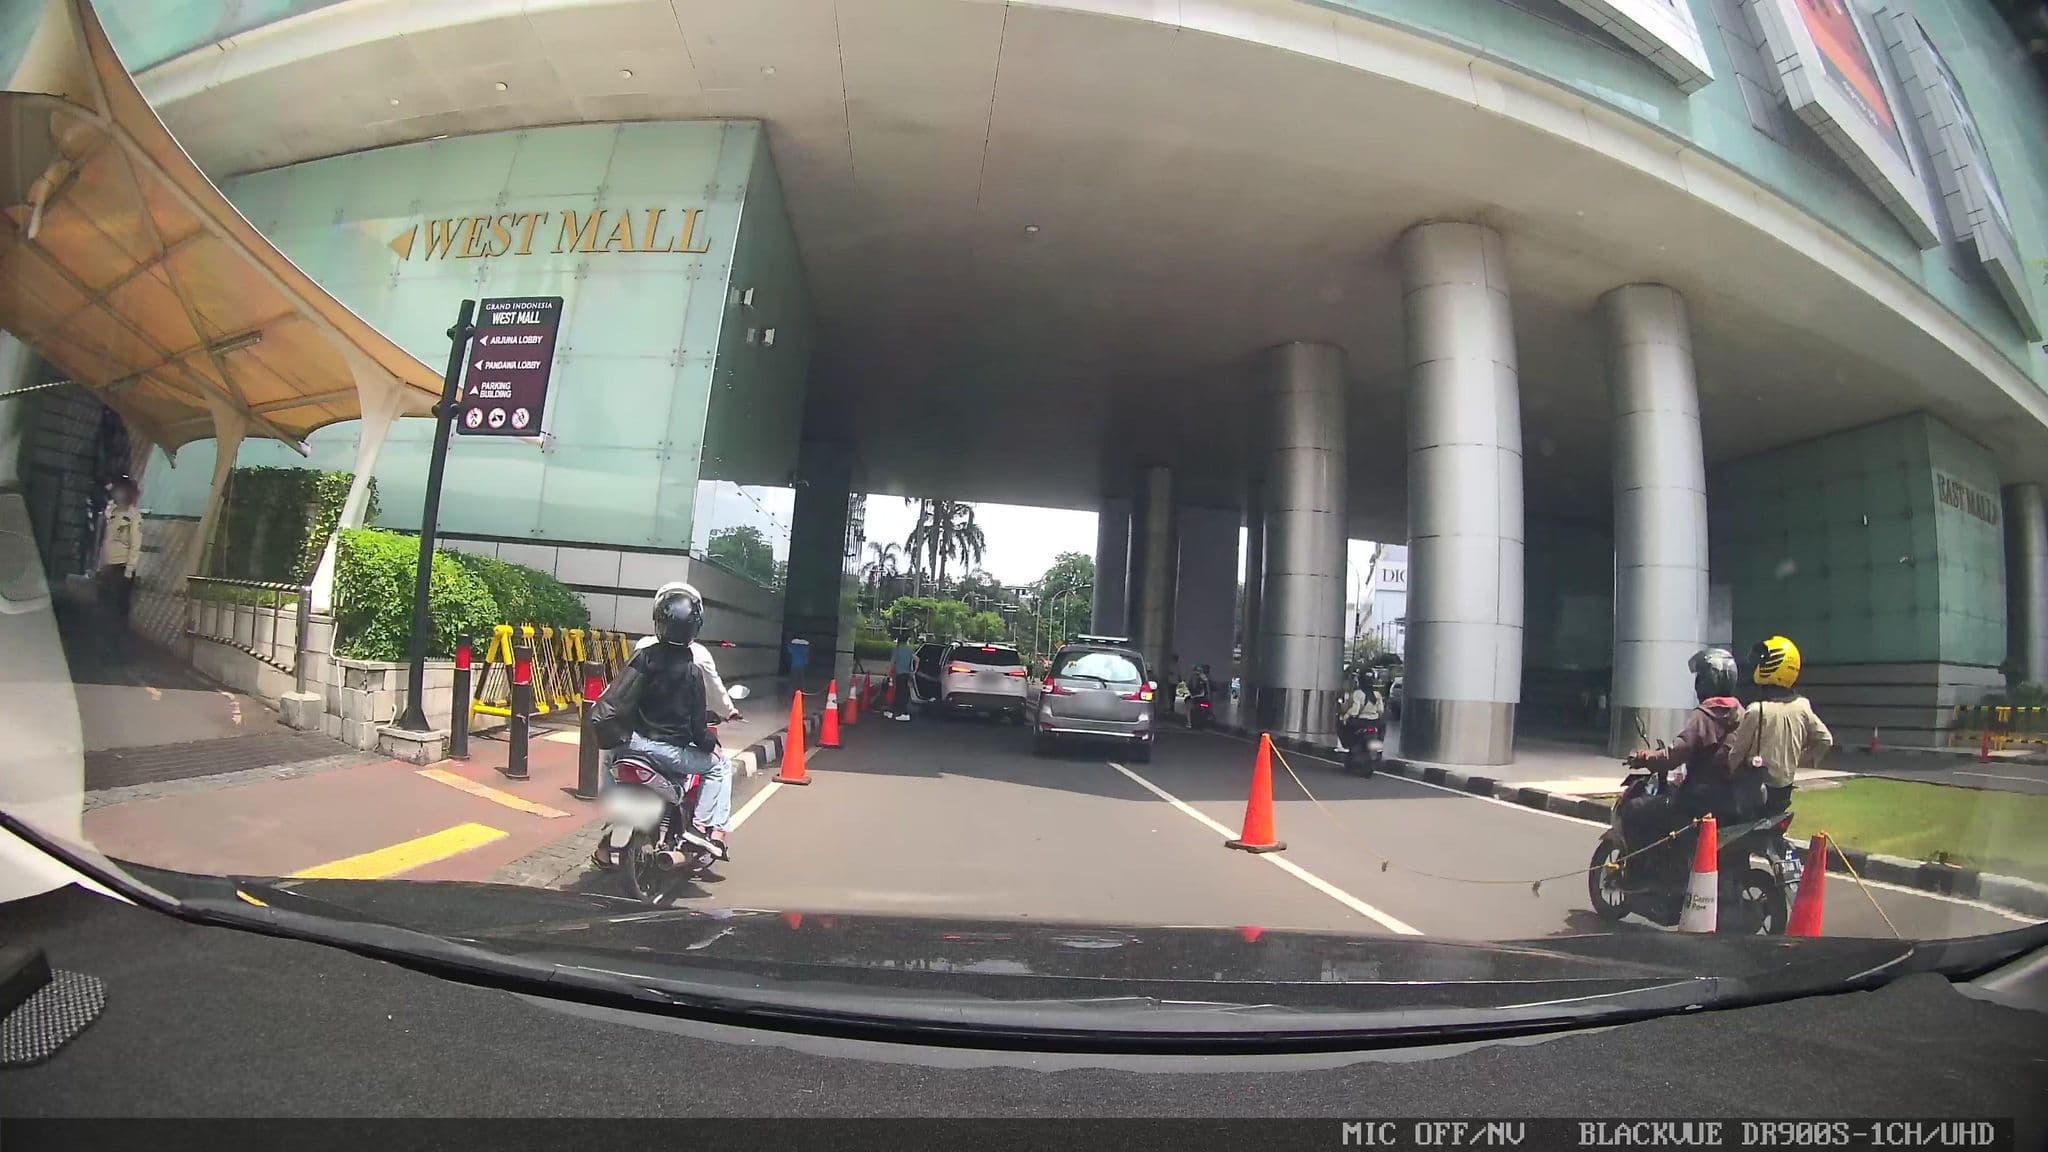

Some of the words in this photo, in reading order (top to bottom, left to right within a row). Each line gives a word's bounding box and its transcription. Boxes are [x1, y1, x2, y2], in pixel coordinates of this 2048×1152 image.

[424, 212, 549, 261] WEST
[550, 207, 712, 254] MALL
[512, 301, 553, 310] INDONESIA
[492, 312, 515, 324] WEST
[516, 311, 541, 324] MALL
[490, 336, 518, 344] ARJUNA
[518, 335, 544, 344] LOBBY
[517, 361, 542, 370] LOBBY
[481, 382, 512, 390] PARKING
[479, 390, 513, 399] BUILDING
[1937, 473, 1968, 511] EAST
